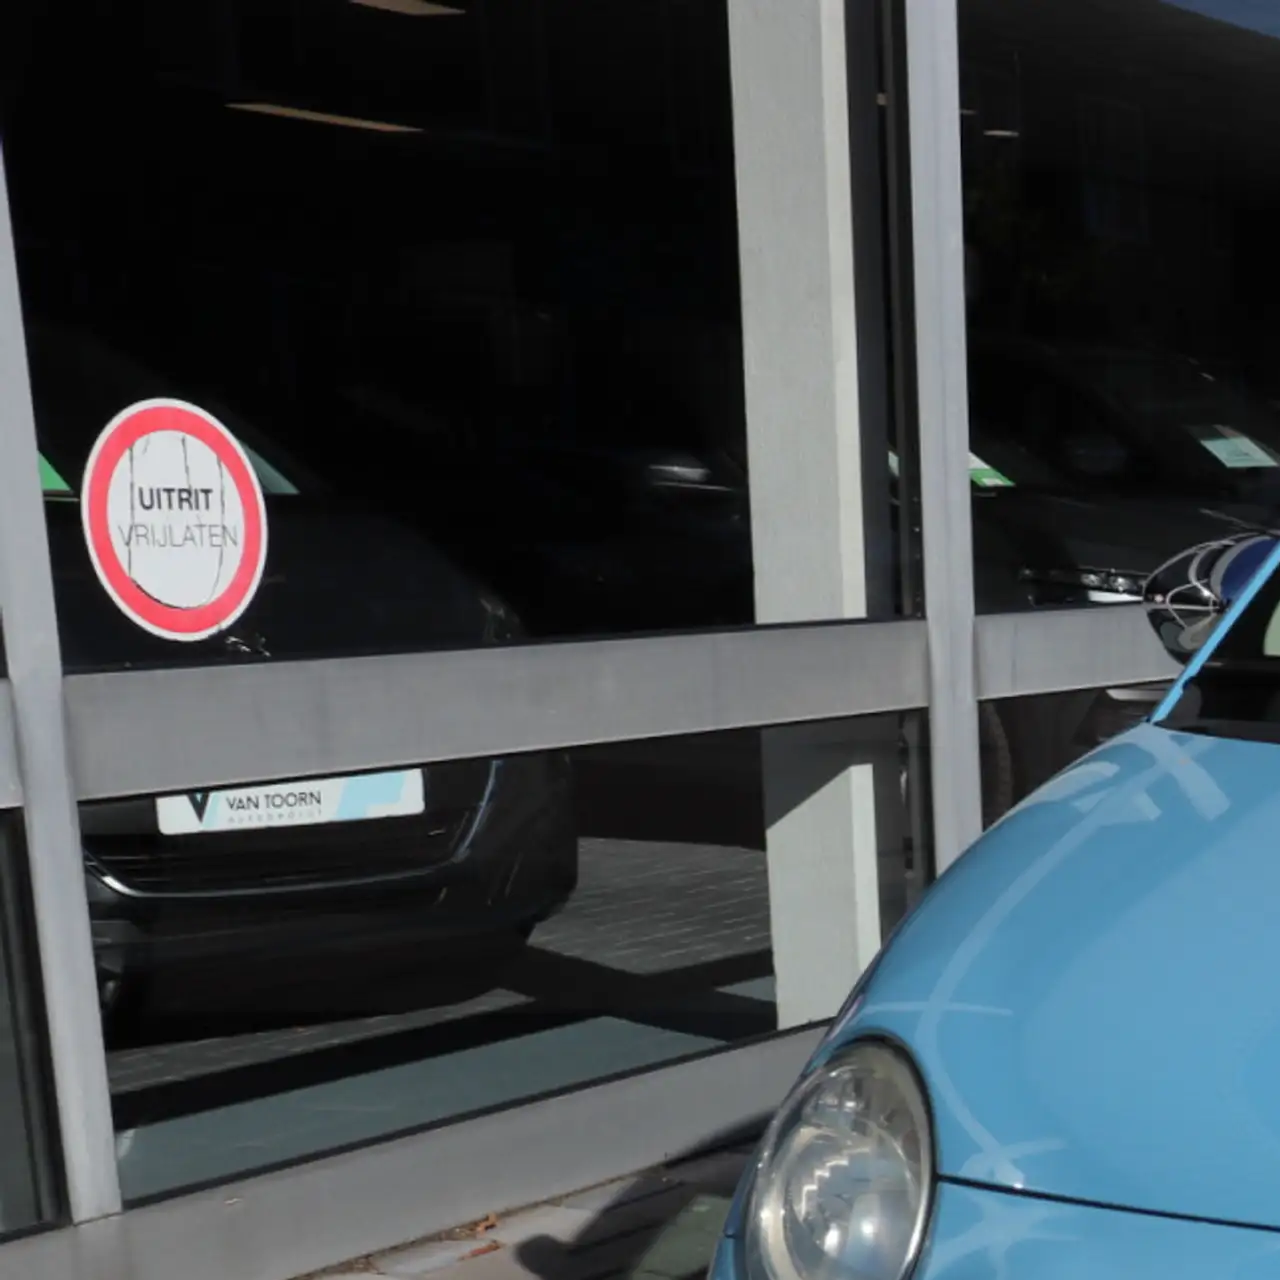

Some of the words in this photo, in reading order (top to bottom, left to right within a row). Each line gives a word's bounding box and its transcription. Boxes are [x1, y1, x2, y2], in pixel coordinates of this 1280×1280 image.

[138, 486, 213, 511] UITRIT
[117, 523, 238, 548] VRIJLATEN
[226, 795, 259, 811] VAN
[264, 790, 322, 809] TOORN
